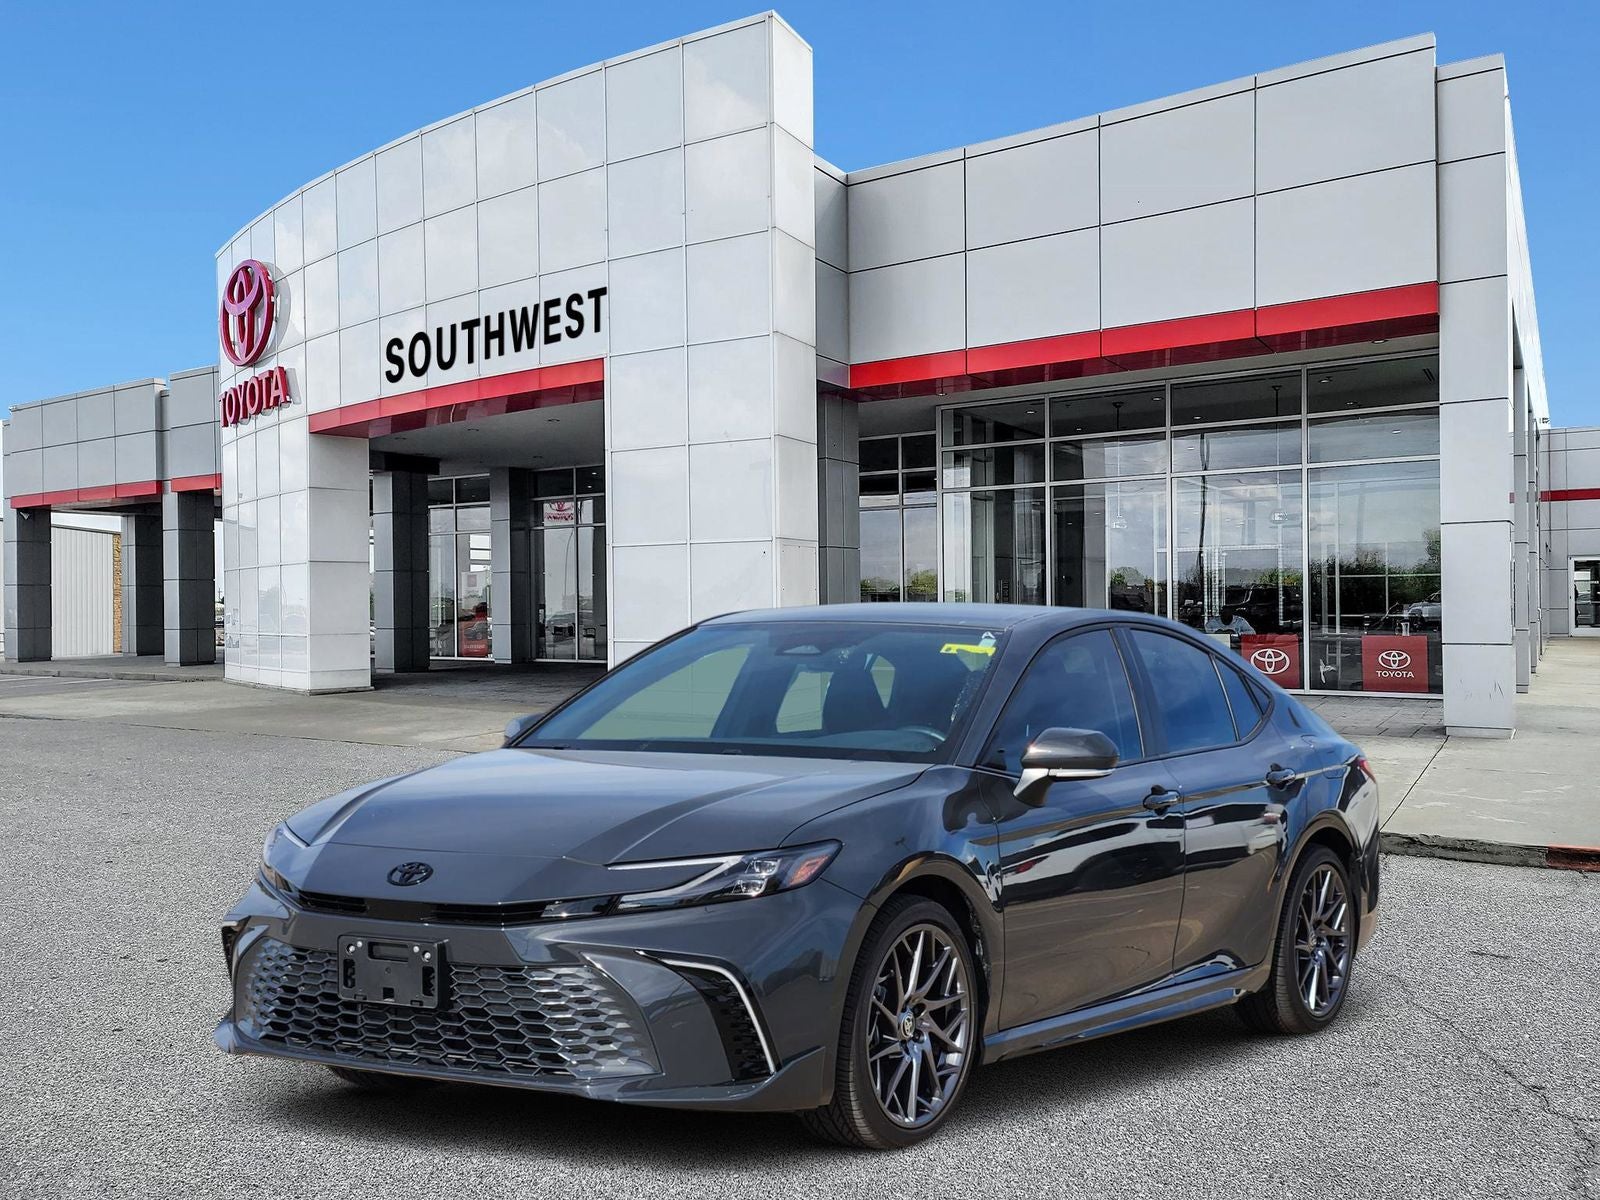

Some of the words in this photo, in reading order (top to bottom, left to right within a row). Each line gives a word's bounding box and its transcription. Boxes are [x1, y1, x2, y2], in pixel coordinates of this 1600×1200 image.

[385, 286, 607, 383] SOUTHWEST
[219, 366, 291, 427] TOYOTA
[1375, 670, 1415, 678] TOYOTA
